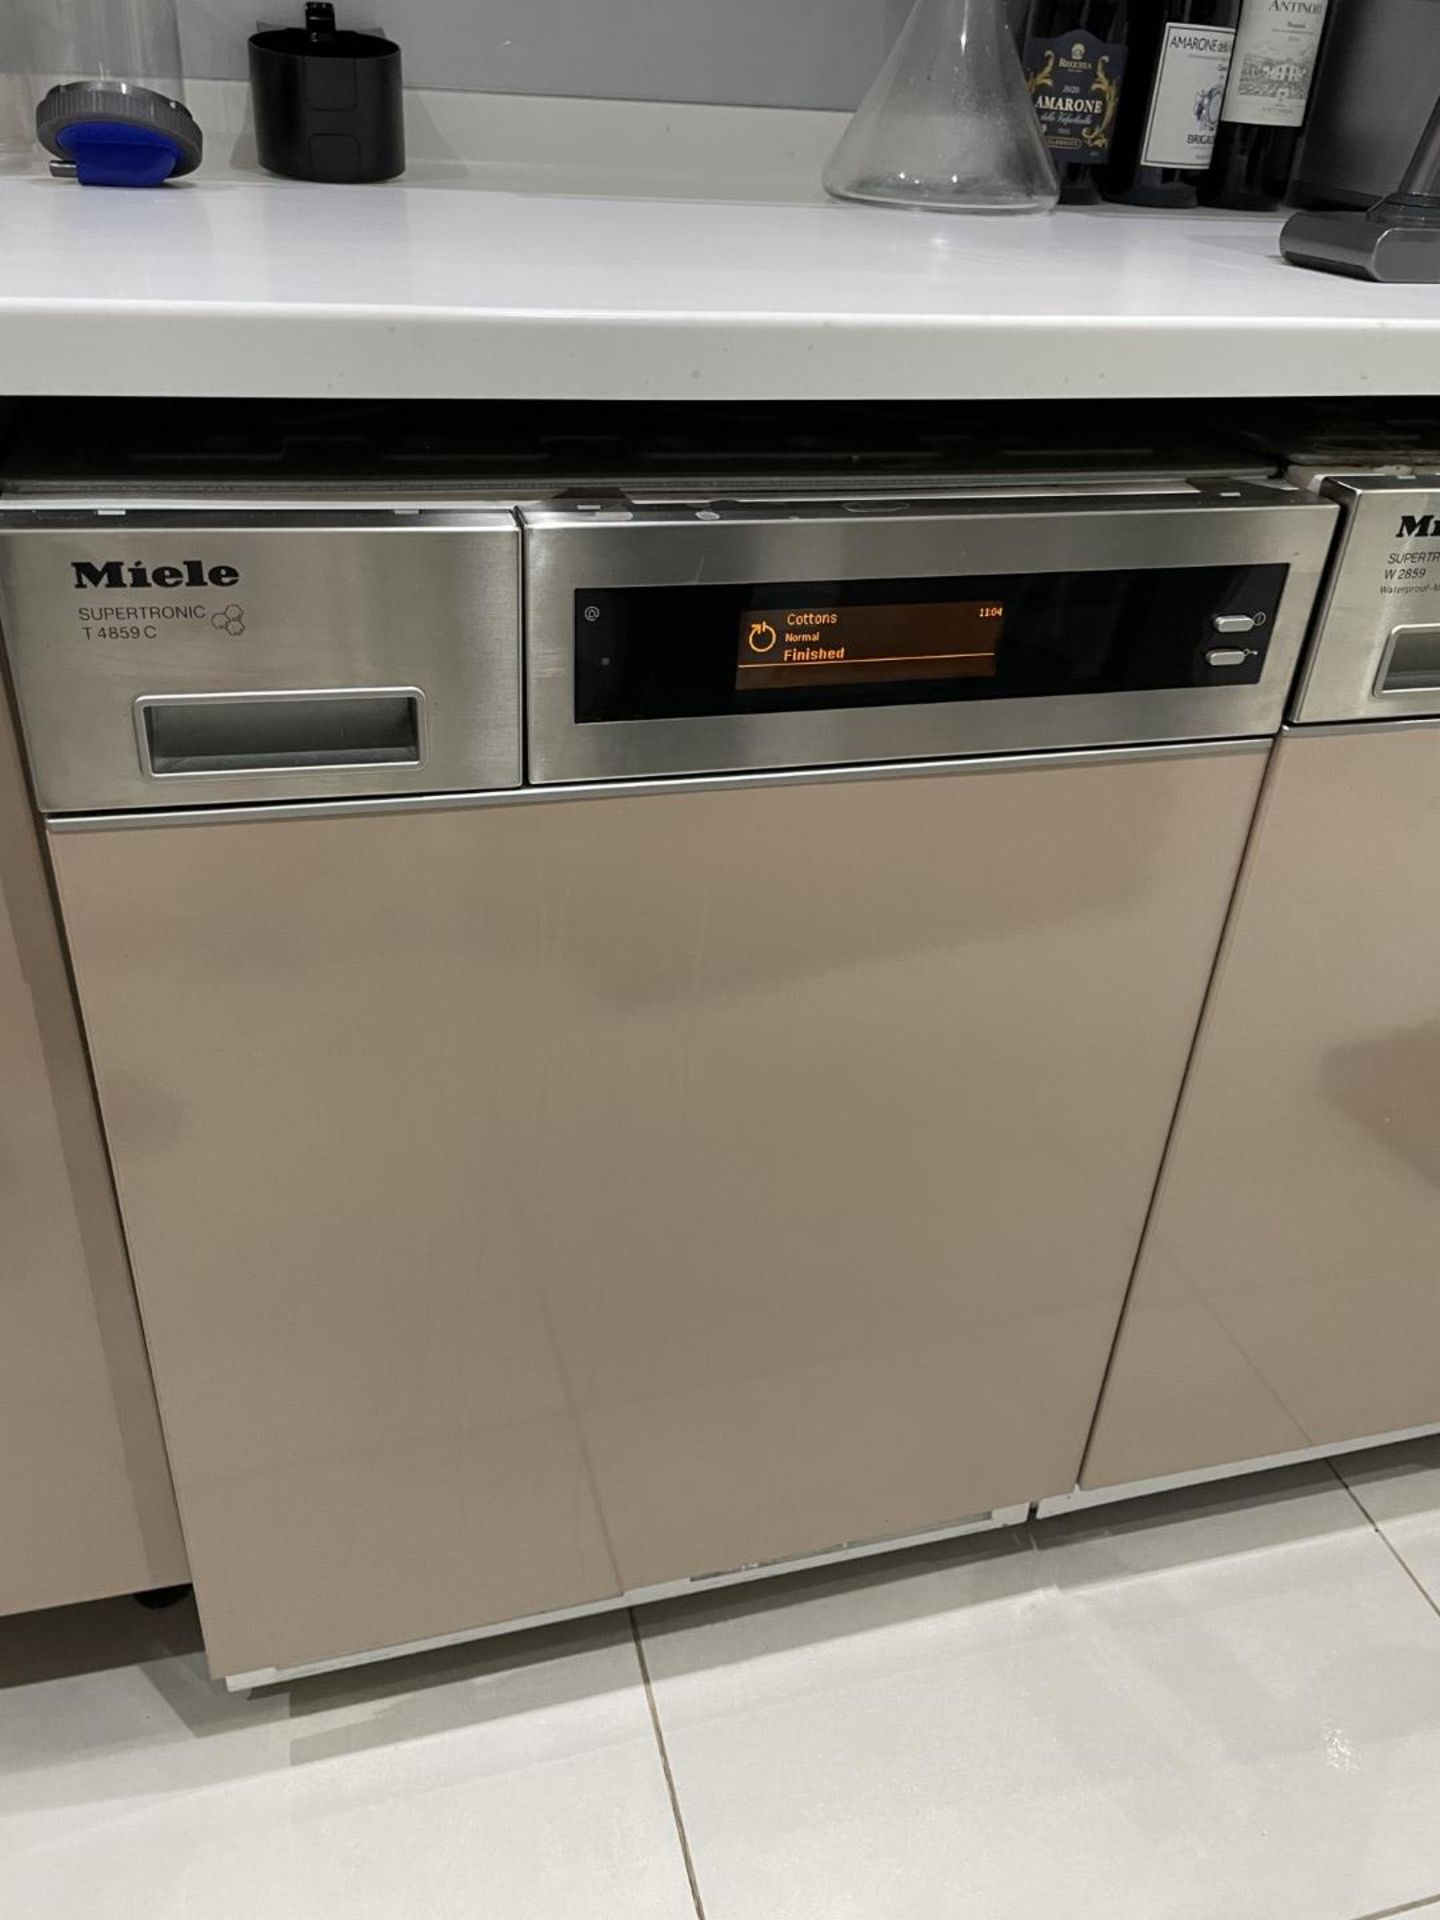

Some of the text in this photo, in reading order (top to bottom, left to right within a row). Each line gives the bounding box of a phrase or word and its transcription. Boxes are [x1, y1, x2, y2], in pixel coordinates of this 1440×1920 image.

[1169, 36, 1217, 53] AMARONE
[1035, 95, 1103, 114] AMARONE
[71, 560, 240, 589] Miele
[1383, 567, 1427, 581] W 2859
[78, 604, 206, 622] SUPERTRONIC
[786, 612, 838, 626] Cottons
[978, 606, 1004, 618] 11:04
[82, 625, 157, 641] T 4859 C
[784, 631, 820, 643] Normal
[783, 647, 845, 662] Finished
